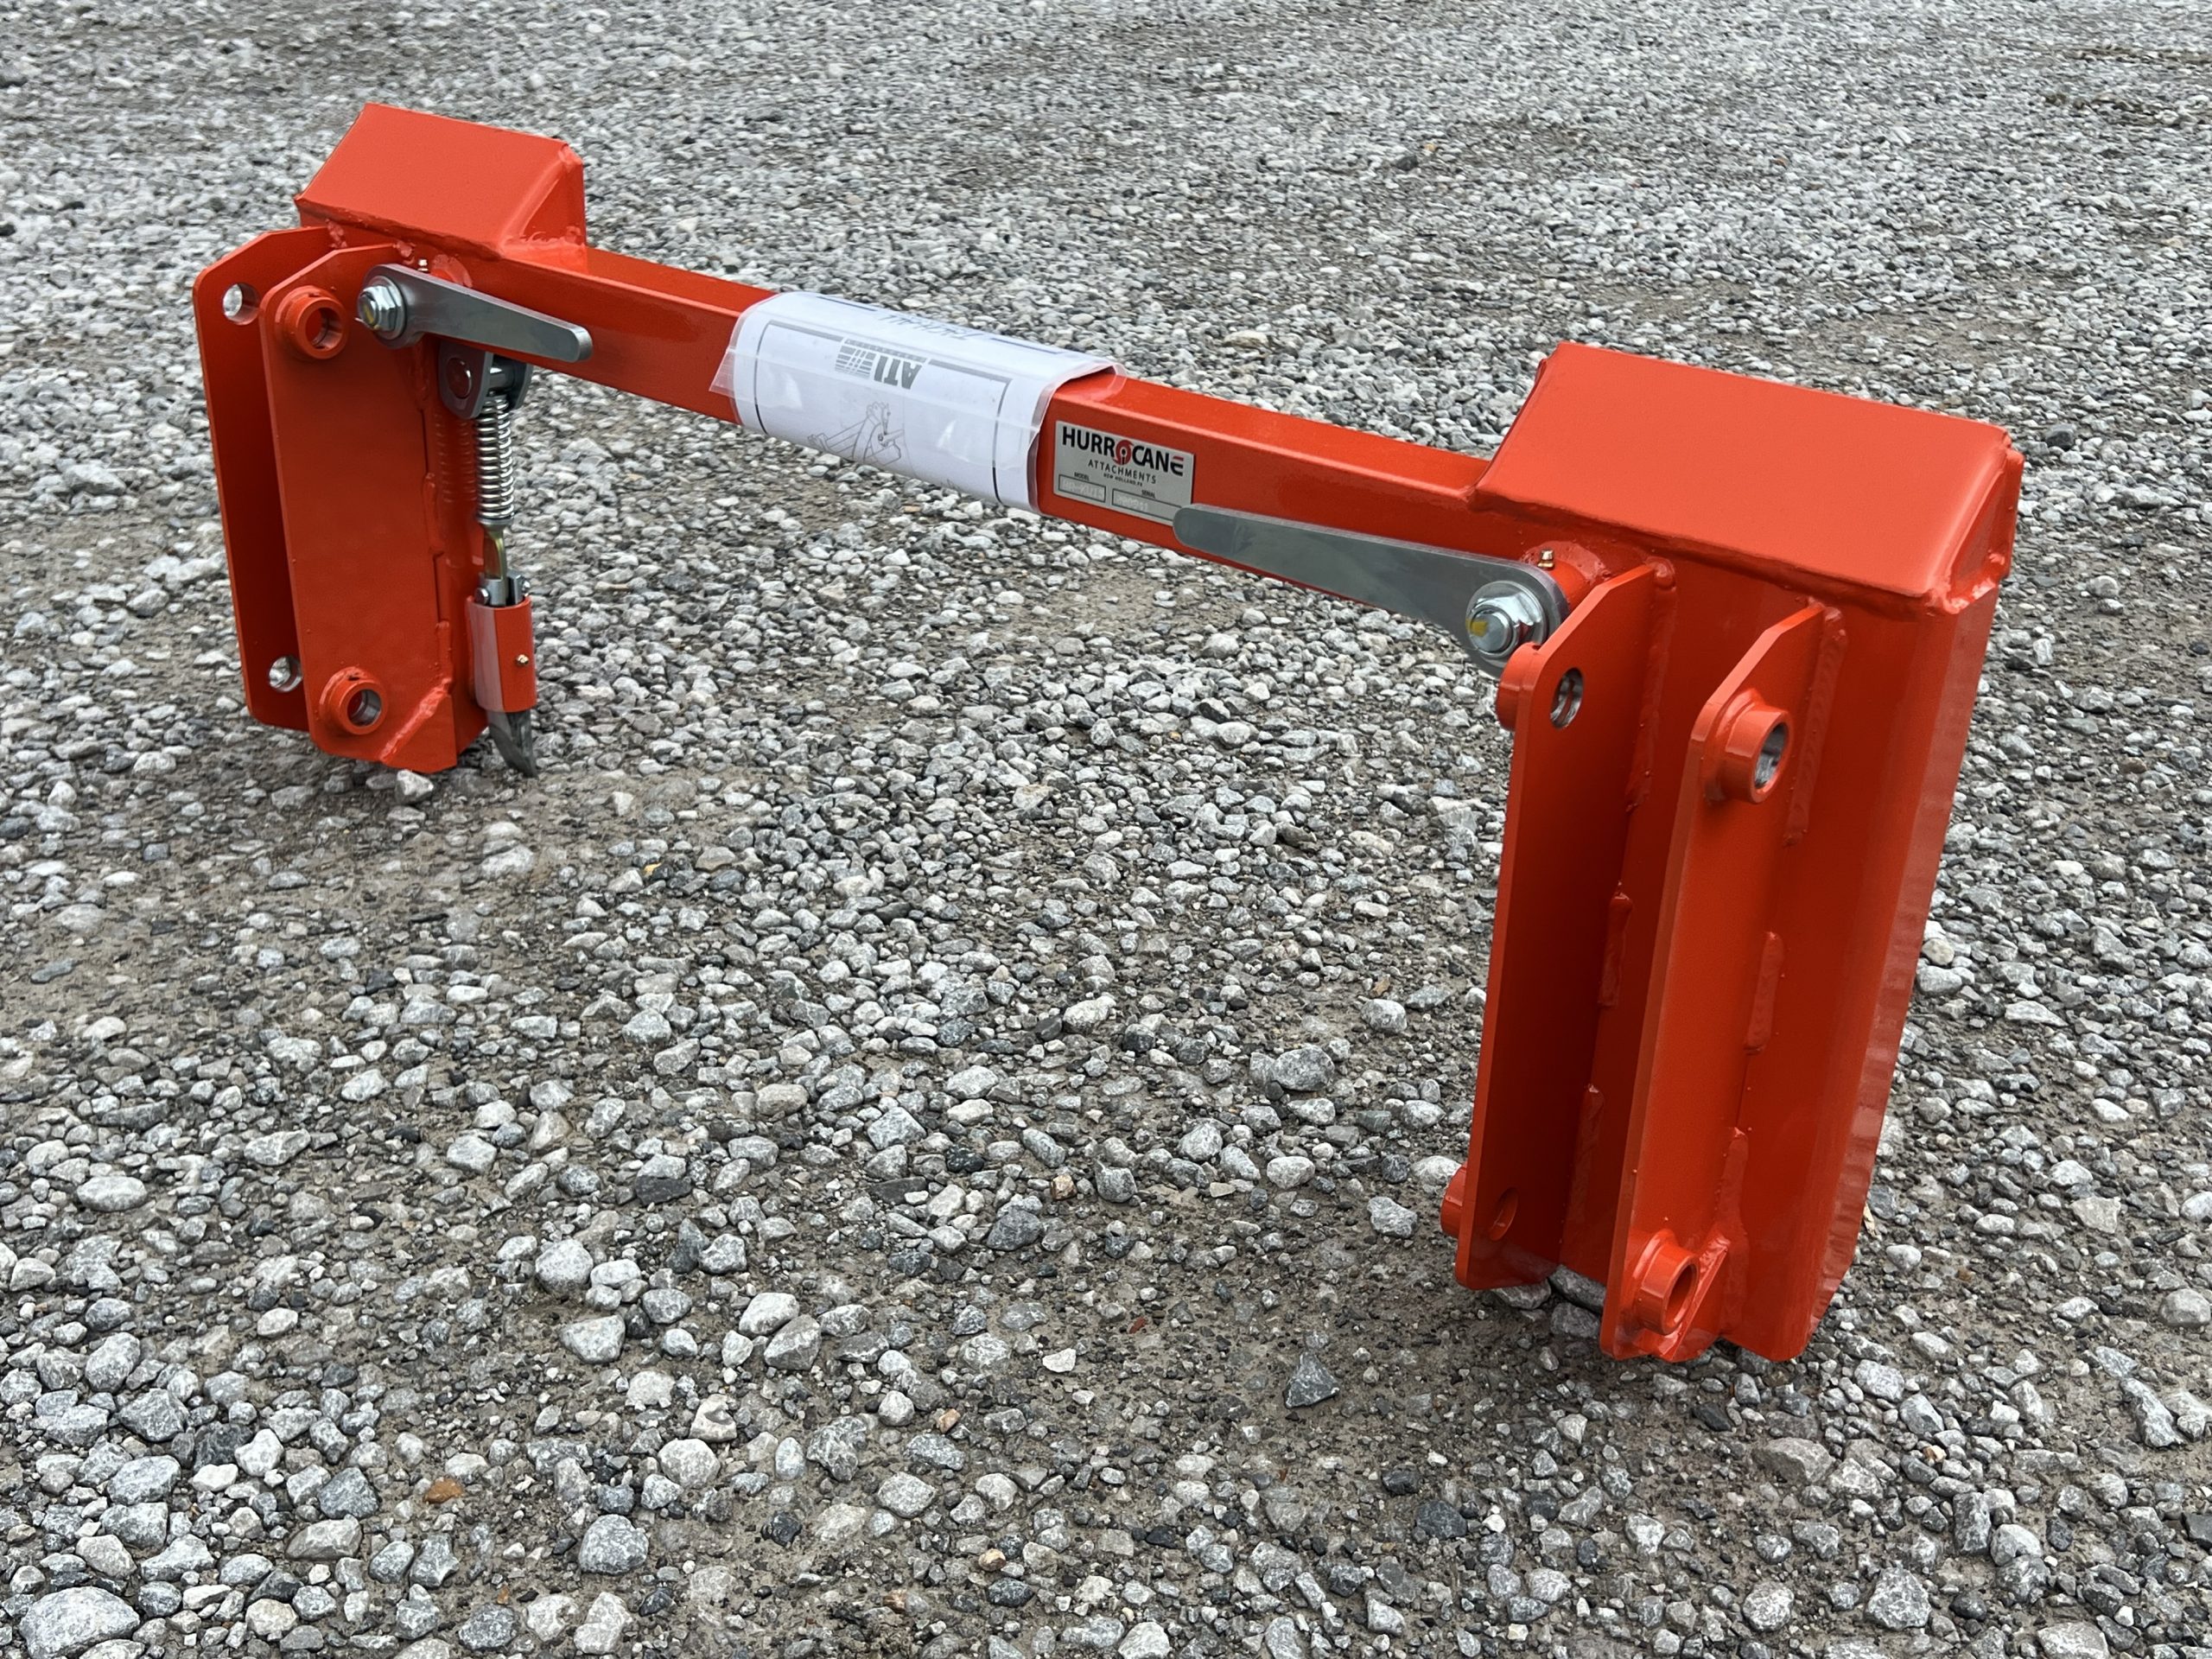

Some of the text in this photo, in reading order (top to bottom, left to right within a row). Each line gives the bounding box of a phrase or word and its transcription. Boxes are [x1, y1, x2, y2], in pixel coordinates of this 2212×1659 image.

[874, 355, 923, 390] ATI
[1074, 472, 1090, 481] MODEL
[1088, 459, 1157, 485] ATTACHMENTS
[1141, 489, 1156, 499] SERIAL
